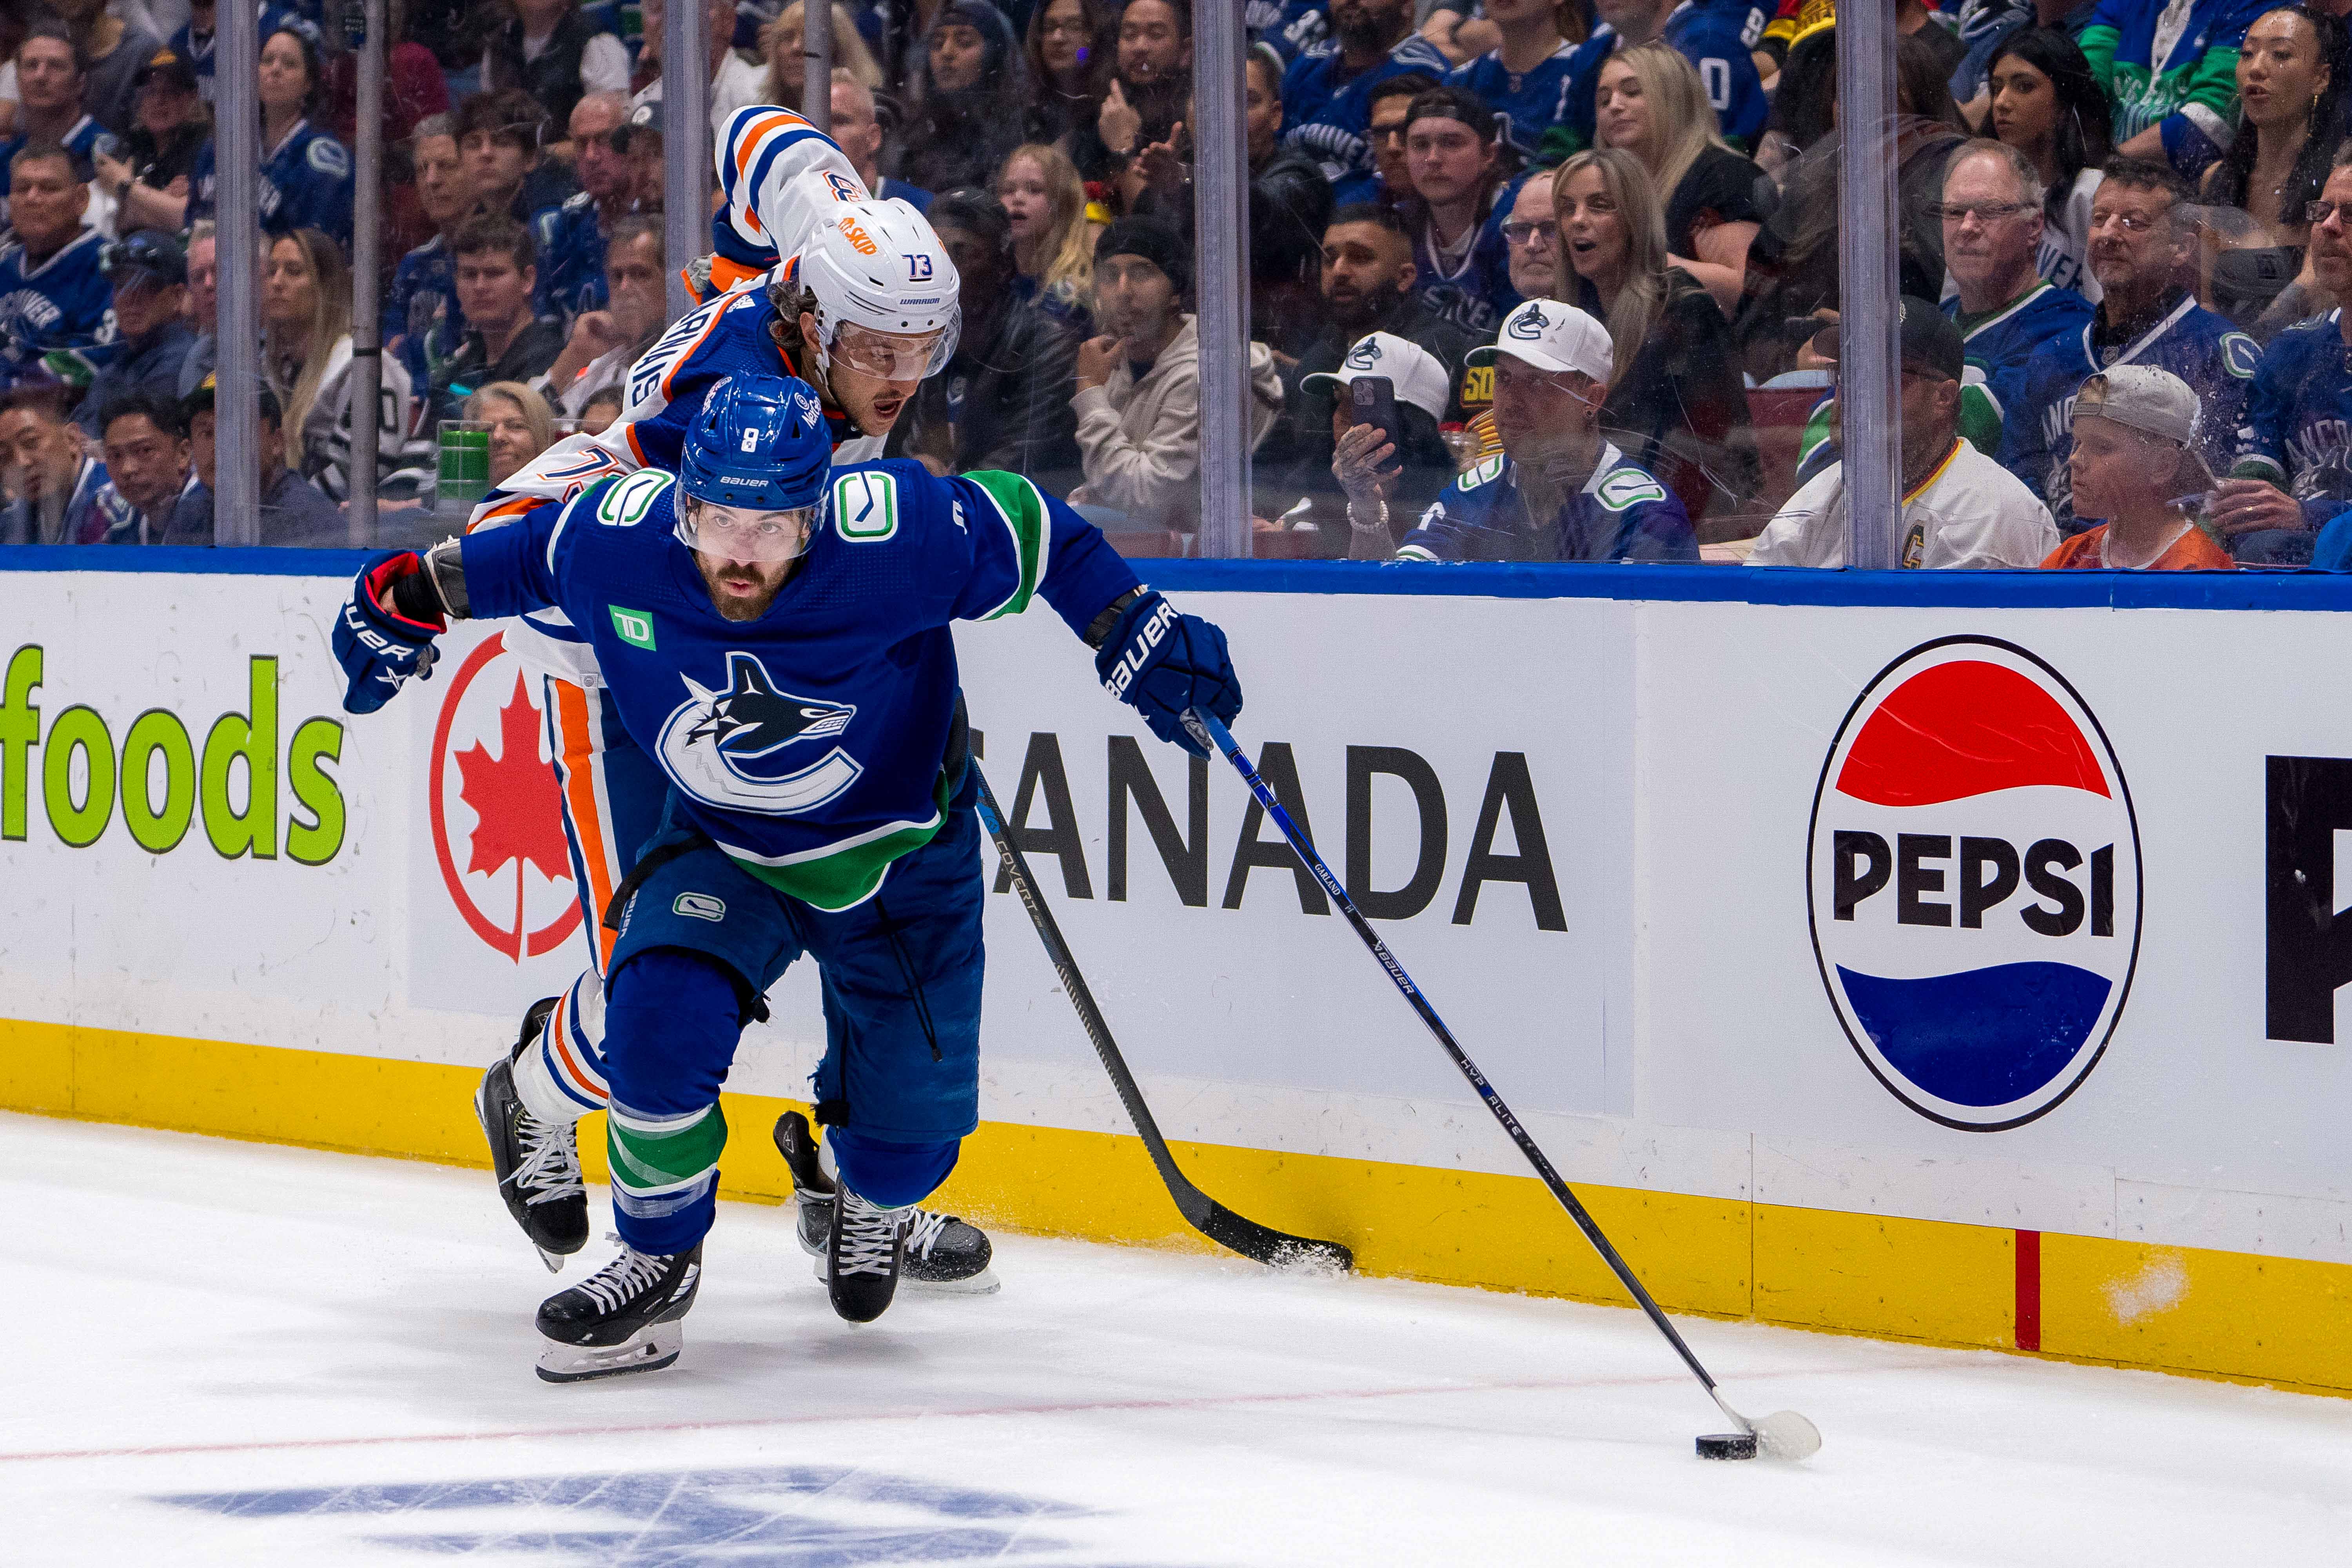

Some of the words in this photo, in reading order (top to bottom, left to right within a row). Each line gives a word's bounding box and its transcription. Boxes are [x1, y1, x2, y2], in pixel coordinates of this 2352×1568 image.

[845, 226, 878, 256] SKIP
[902, 254, 934, 278] 73
[740, 427, 759, 453] 8
[720, 476, 769, 488] BAUER
[614, 612, 650, 642] TD
[1104, 601, 1179, 702] BAUER
[0, 643, 347, 866] foods
[970, 727, 1568, 933] ANADA
[996, 840, 1040, 911] COVERT
[1314, 863, 1341, 896] GARLAND
[1833, 830, 2114, 938] PEPSI
[1379, 951, 1415, 994] BAUER
[1461, 1058, 1522, 1137] HYPRLITE
